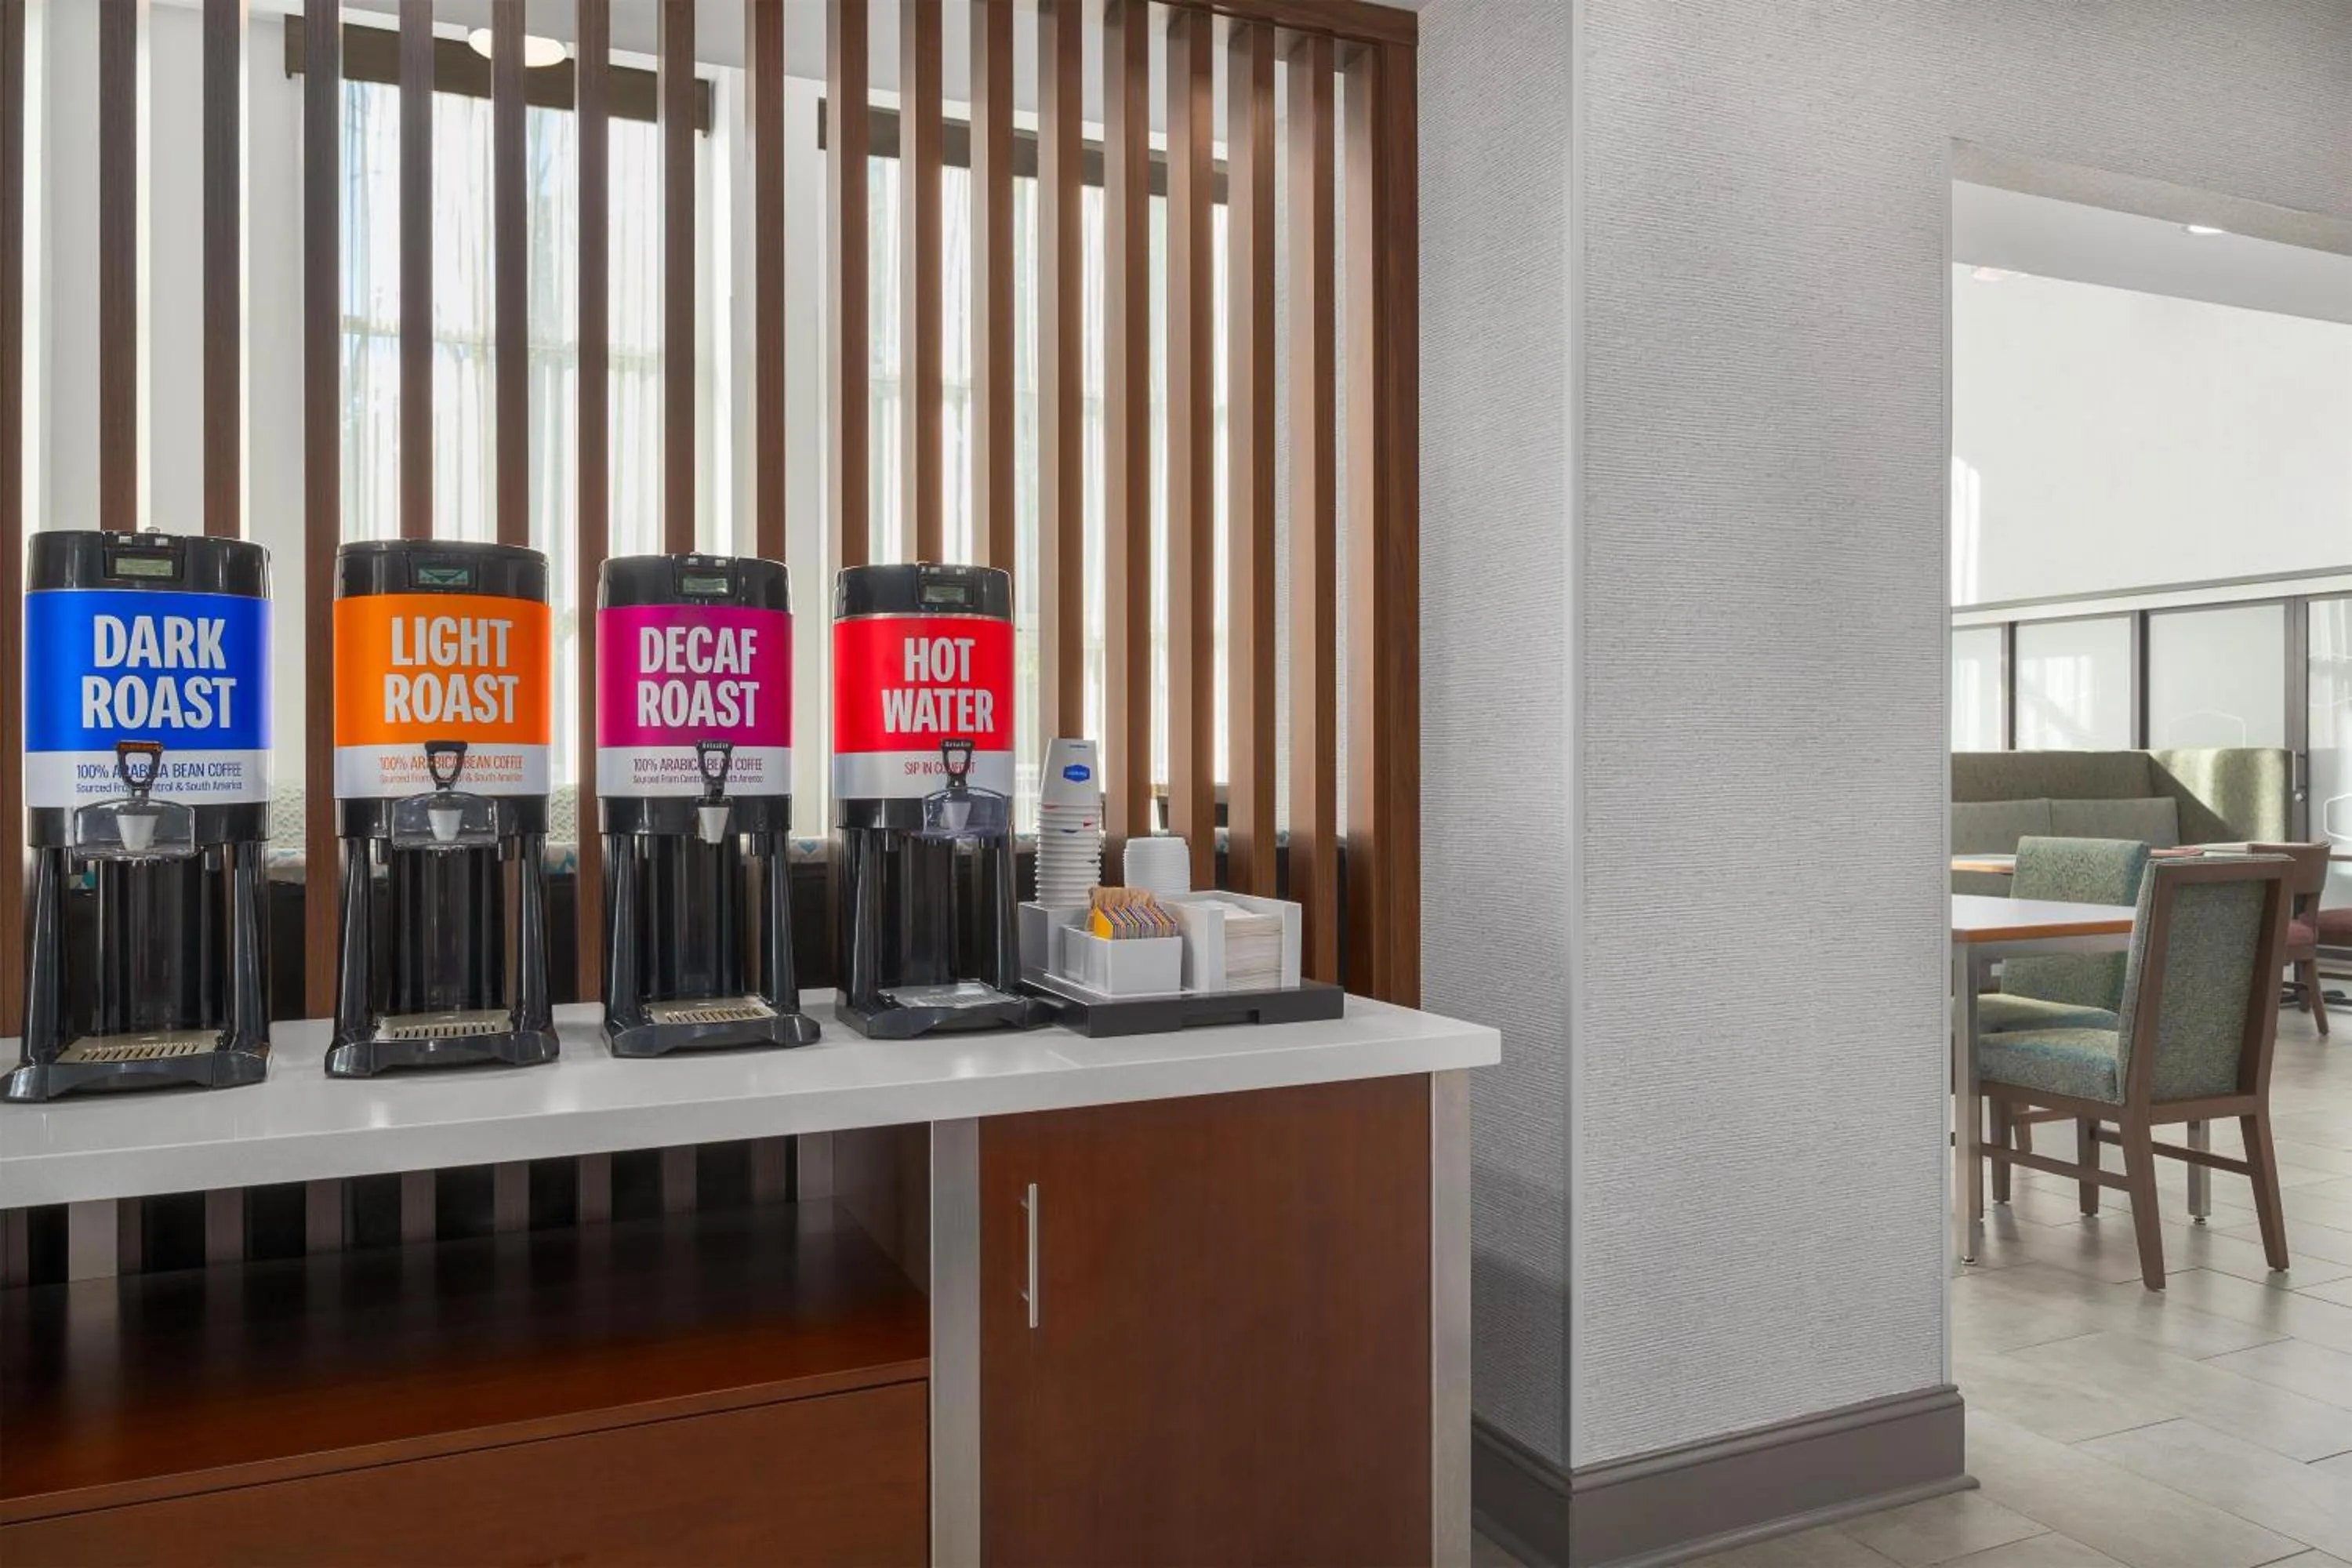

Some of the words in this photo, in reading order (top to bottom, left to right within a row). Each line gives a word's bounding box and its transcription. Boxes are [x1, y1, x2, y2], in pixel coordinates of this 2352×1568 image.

[93, 615, 227, 670] DARK
[391, 616, 514, 667] LIGHT
[640, 626, 758, 674] DECAF
[904, 637, 975, 682] HOT
[82, 675, 238, 729] ROAST
[383, 673, 519, 724] ROAST
[637, 680, 760, 728] ROAST
[881, 688, 995, 733] WATER
[76, 764, 109, 779] 100%
[172, 763, 205, 778] BEAN
[208, 761, 242, 777] COFFEE
[379, 757, 408, 770] 100%
[494, 755, 523, 768] COFFEE
[633, 758, 659, 771] 100%
[659, 758, 698, 771] ARABIC
[735, 758, 762, 771] COFFEE
[904, 761, 920, 775] SIP
[922, 760, 932, 774] IN
[76, 783, 112, 793] Sourced
[175, 782, 183, 791] &
[185, 782, 211, 791] South
[212, 781, 242, 790] America
